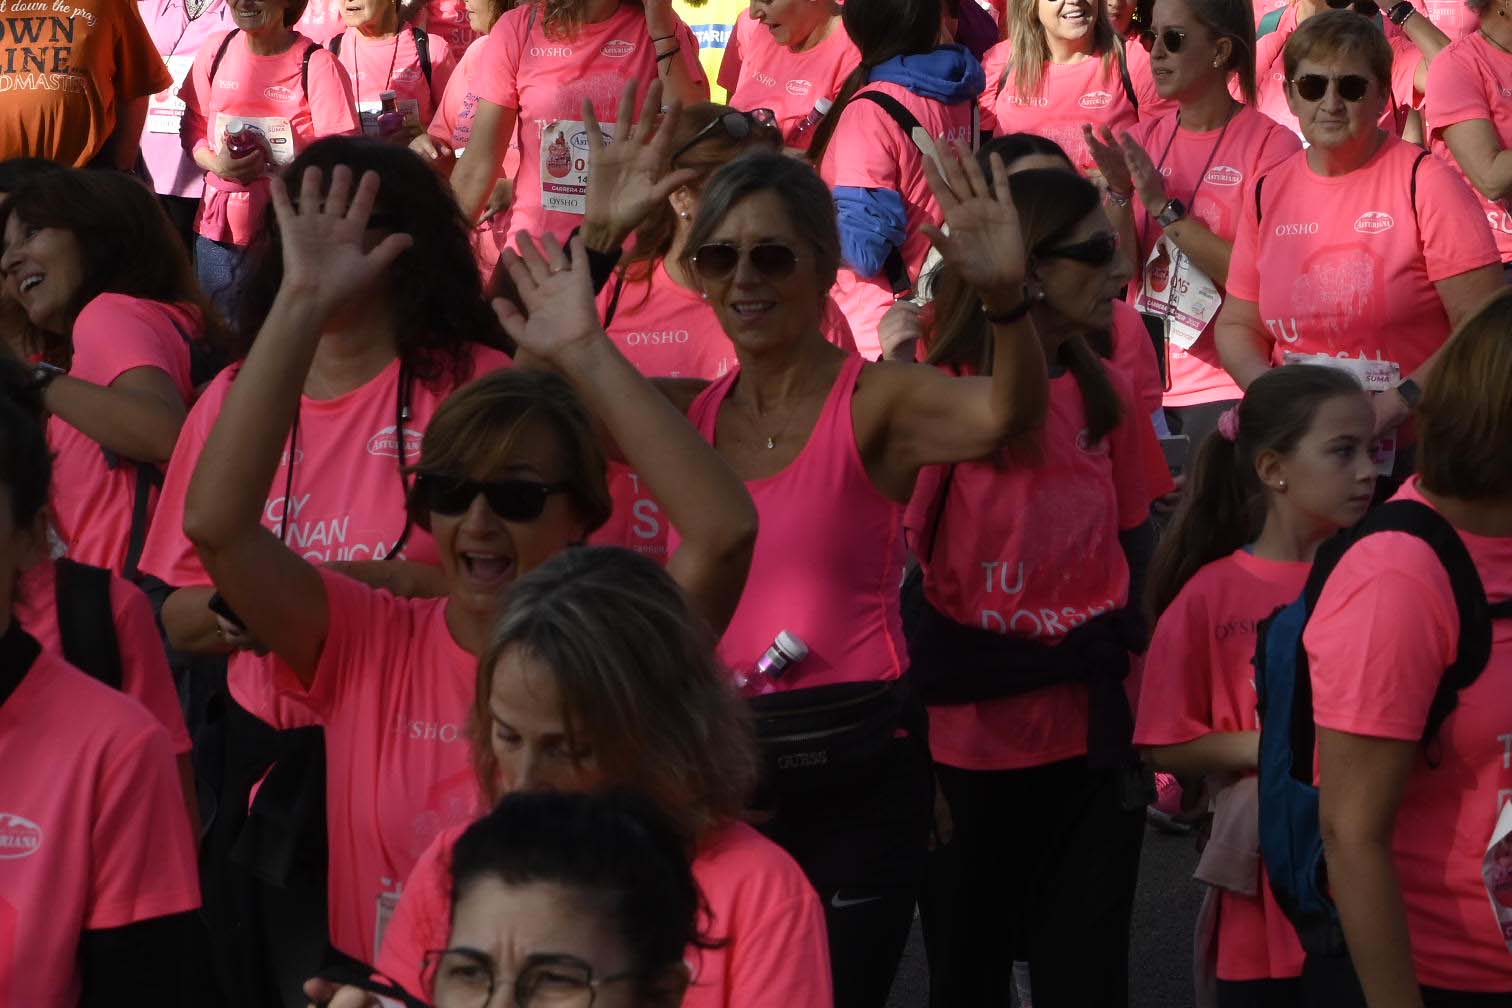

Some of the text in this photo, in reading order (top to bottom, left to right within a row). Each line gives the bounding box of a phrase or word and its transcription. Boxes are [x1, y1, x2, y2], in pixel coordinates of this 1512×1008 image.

[52, 0, 71, 14] the
[530, 47, 573, 58] OYSHO
[551, 184, 578, 193] CARRERA
[549, 197, 578, 207] OYSHO
[1275, 221, 1319, 236] OYSHO
[1354, 218, 1393, 231] ASTURIANA
[626, 329, 689, 346] OYSHO
[981, 561, 1024, 594] TU
